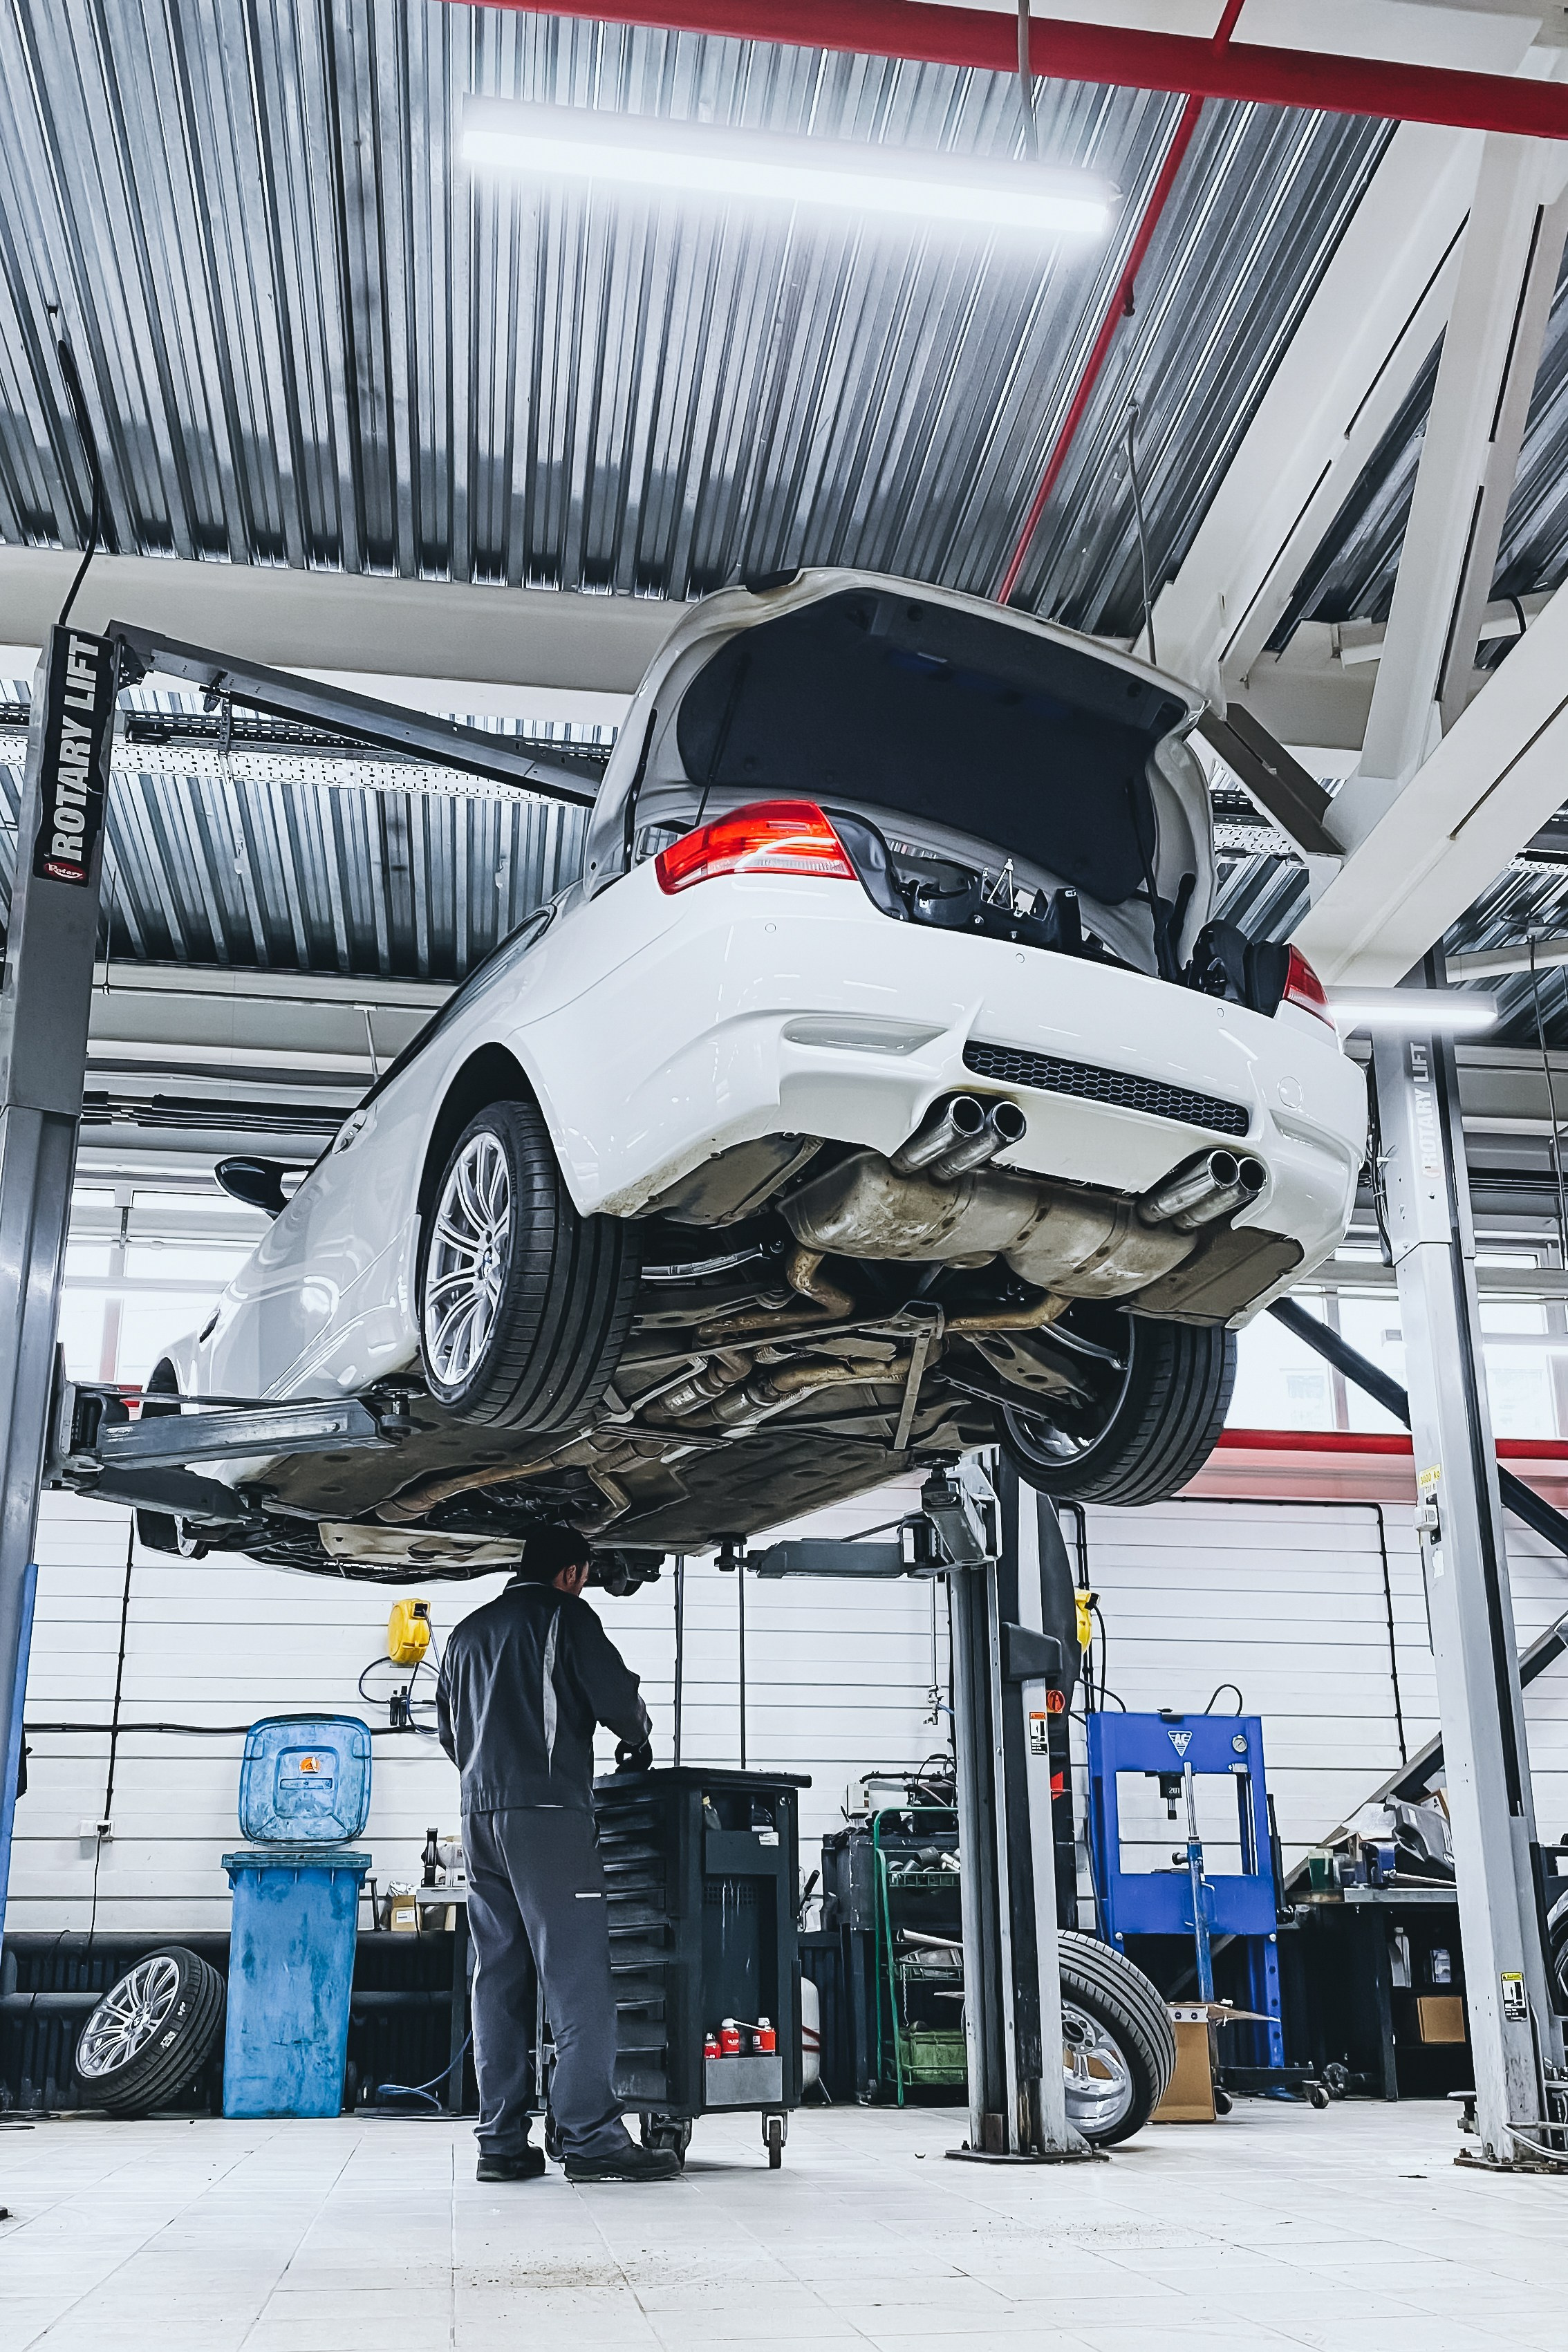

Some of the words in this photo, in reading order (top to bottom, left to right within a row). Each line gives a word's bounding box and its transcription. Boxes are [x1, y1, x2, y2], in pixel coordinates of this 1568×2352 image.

[64, 634, 99, 711] LIFT
[52, 714, 92, 861] ROTARY
[48, 863, 83, 879] Rotary
[1410, 1042, 1429, 1083] LIFT
[1415, 1088, 1439, 1168] ROTARY
